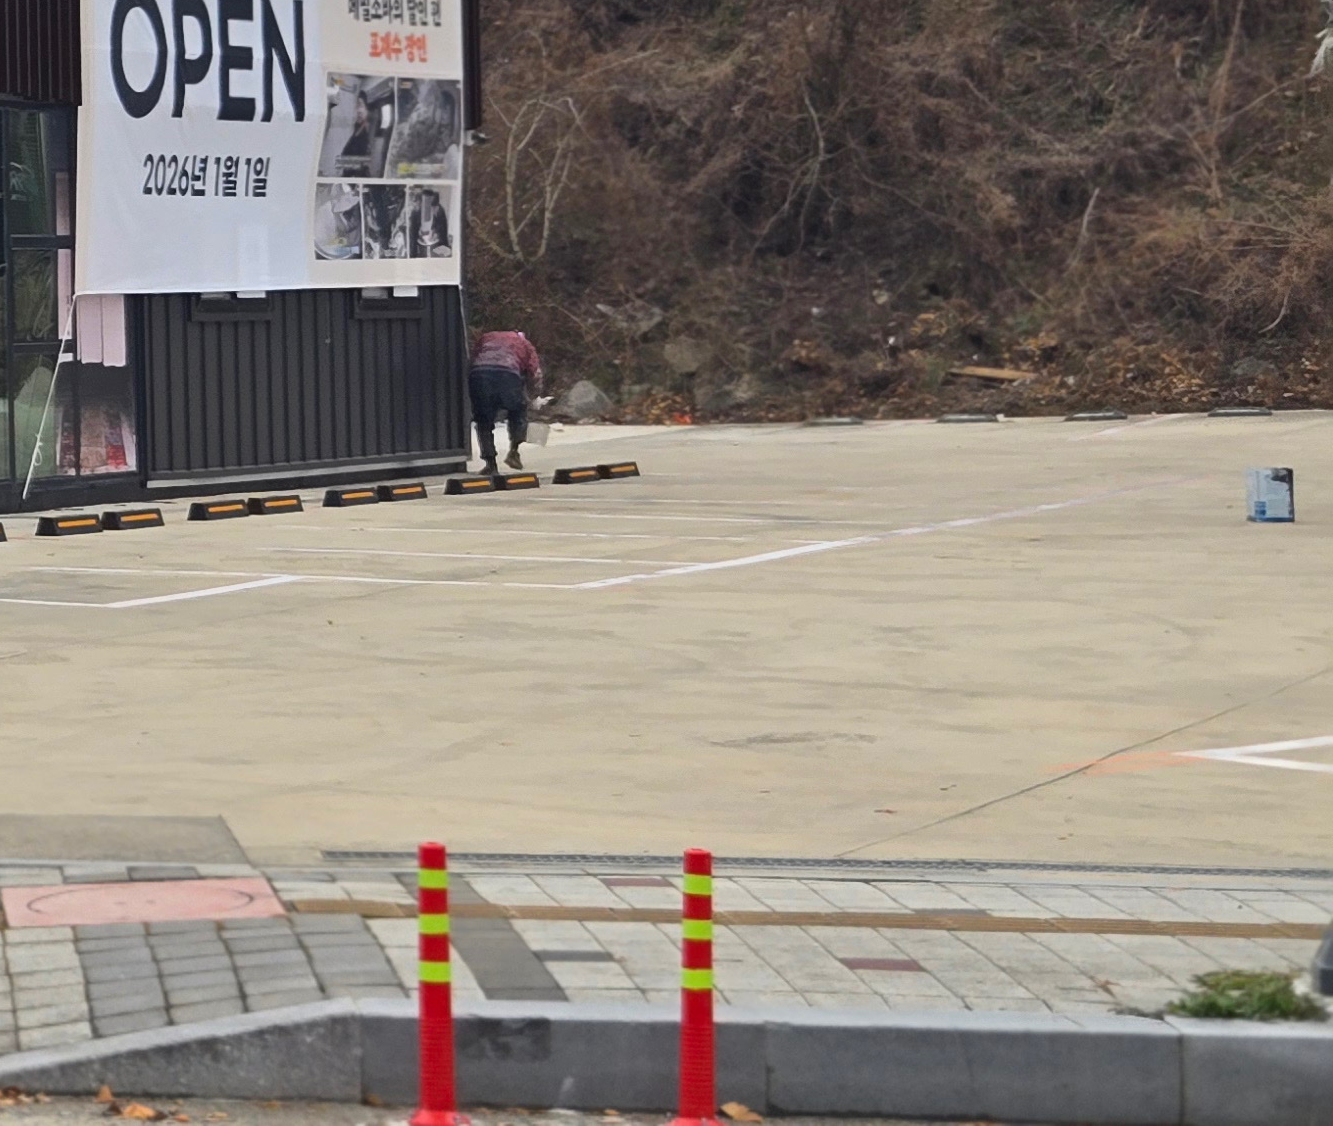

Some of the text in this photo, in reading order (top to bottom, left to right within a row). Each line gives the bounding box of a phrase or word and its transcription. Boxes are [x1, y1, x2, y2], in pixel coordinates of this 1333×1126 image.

[142, 153, 271, 198] 2026년 1월 1일
